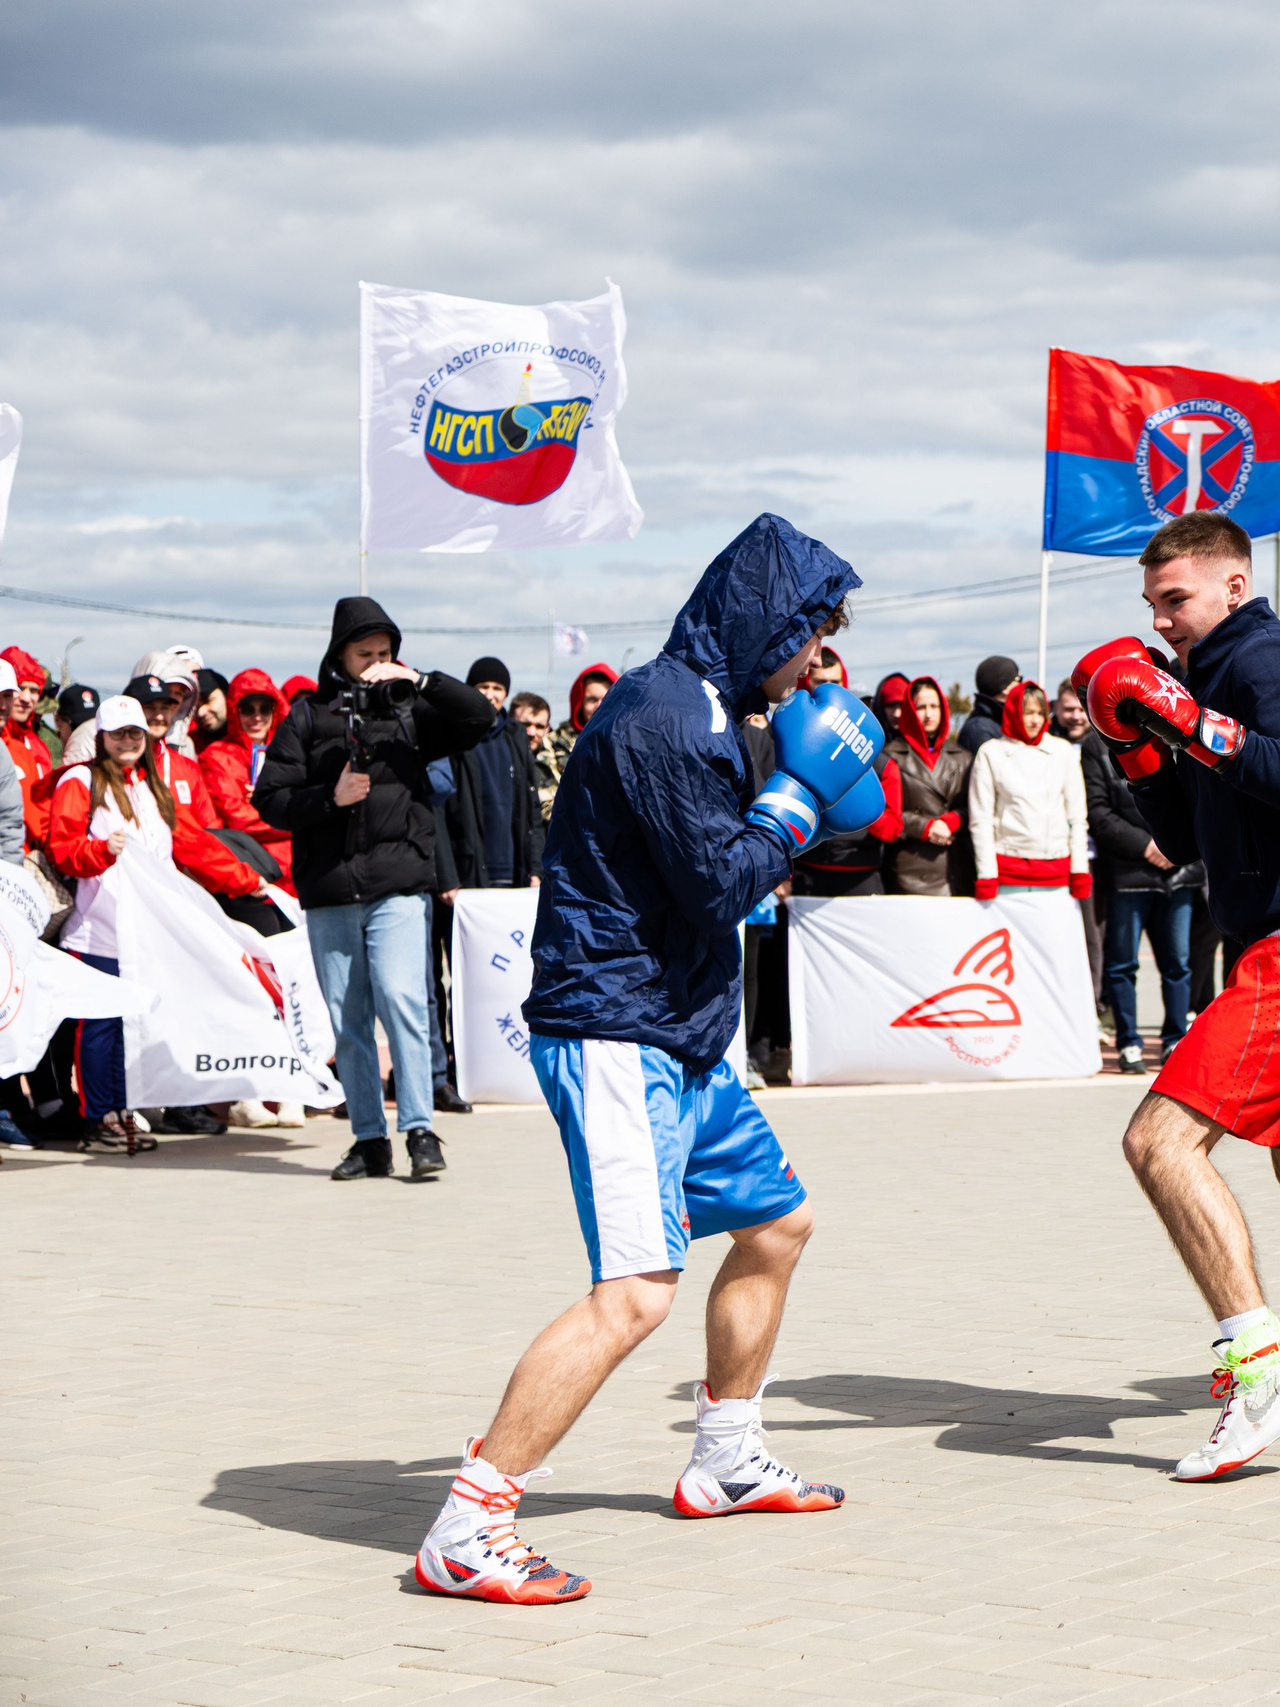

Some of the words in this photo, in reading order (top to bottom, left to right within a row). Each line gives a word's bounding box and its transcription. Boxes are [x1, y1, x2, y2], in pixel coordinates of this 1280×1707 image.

[429, 408, 494, 456] НГСП
[1145, 400, 1222, 430] ОБЛАСТНОЙ
[1223, 407, 1254, 442] СОВЕТ
[1135, 430, 1178, 524] ОЛГОГРАДСКИЙ
[820, 705, 875, 765] clinch
[944, 1034, 1021, 1067] РОСПРОФЖЕЛ
